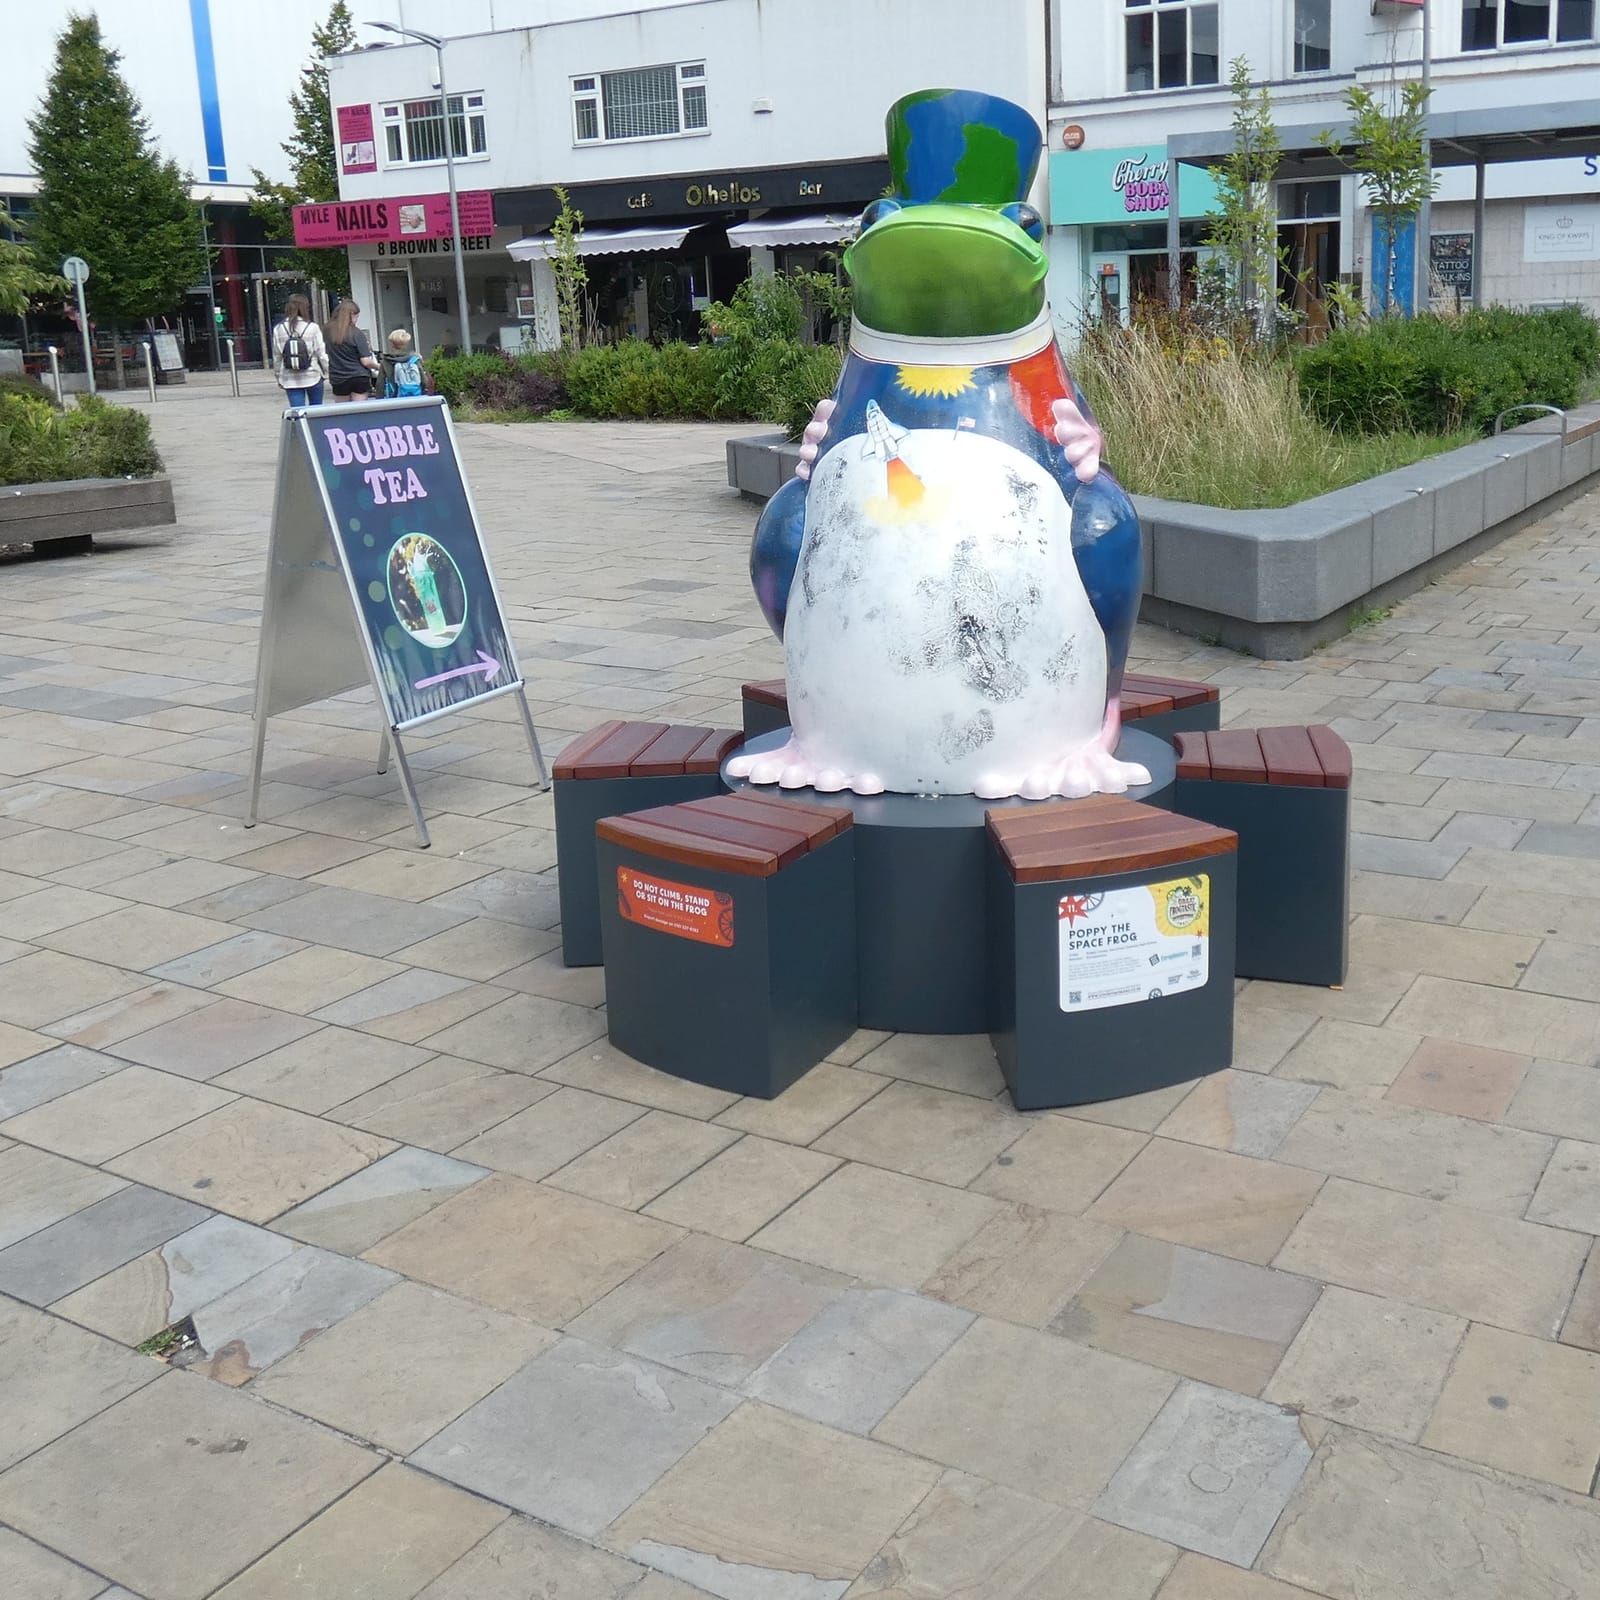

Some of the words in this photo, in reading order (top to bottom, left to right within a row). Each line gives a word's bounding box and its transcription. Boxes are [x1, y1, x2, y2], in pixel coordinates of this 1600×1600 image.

[1112, 153, 1169, 192] Cherry
[685, 182, 761, 206] Othellos
[800, 181, 822, 196] Bar
[1125, 180, 1169, 198] BOBA
[1125, 195, 1169, 213] SHOP
[300, 207, 330, 225] MYLE
[336, 203, 388, 231] NAILS
[377, 241, 385, 255] 8
[389, 238, 437, 255] BROWN
[1433, 260, 1469, 270] TATTOO
[323, 423, 440, 467] BUBBLE
[364, 467, 428, 505] TEA
[633, 880, 643, 890] DO
[644, 883, 658, 894] NOT
[660, 888, 683, 902] CLIMB,
[684, 894, 710, 907] STAND
[635, 890, 646, 900] OR
[647, 894, 657, 903] SIT
[658, 897, 669, 907] ON
[670, 900, 684, 911] THE
[685, 904, 708, 916] FROG
[1069, 926, 1107, 939] POPPY
[1112, 922, 1131, 934] THE
[1069, 938, 1103, 950] SPACE
[1107, 932, 1137, 945] FROG
